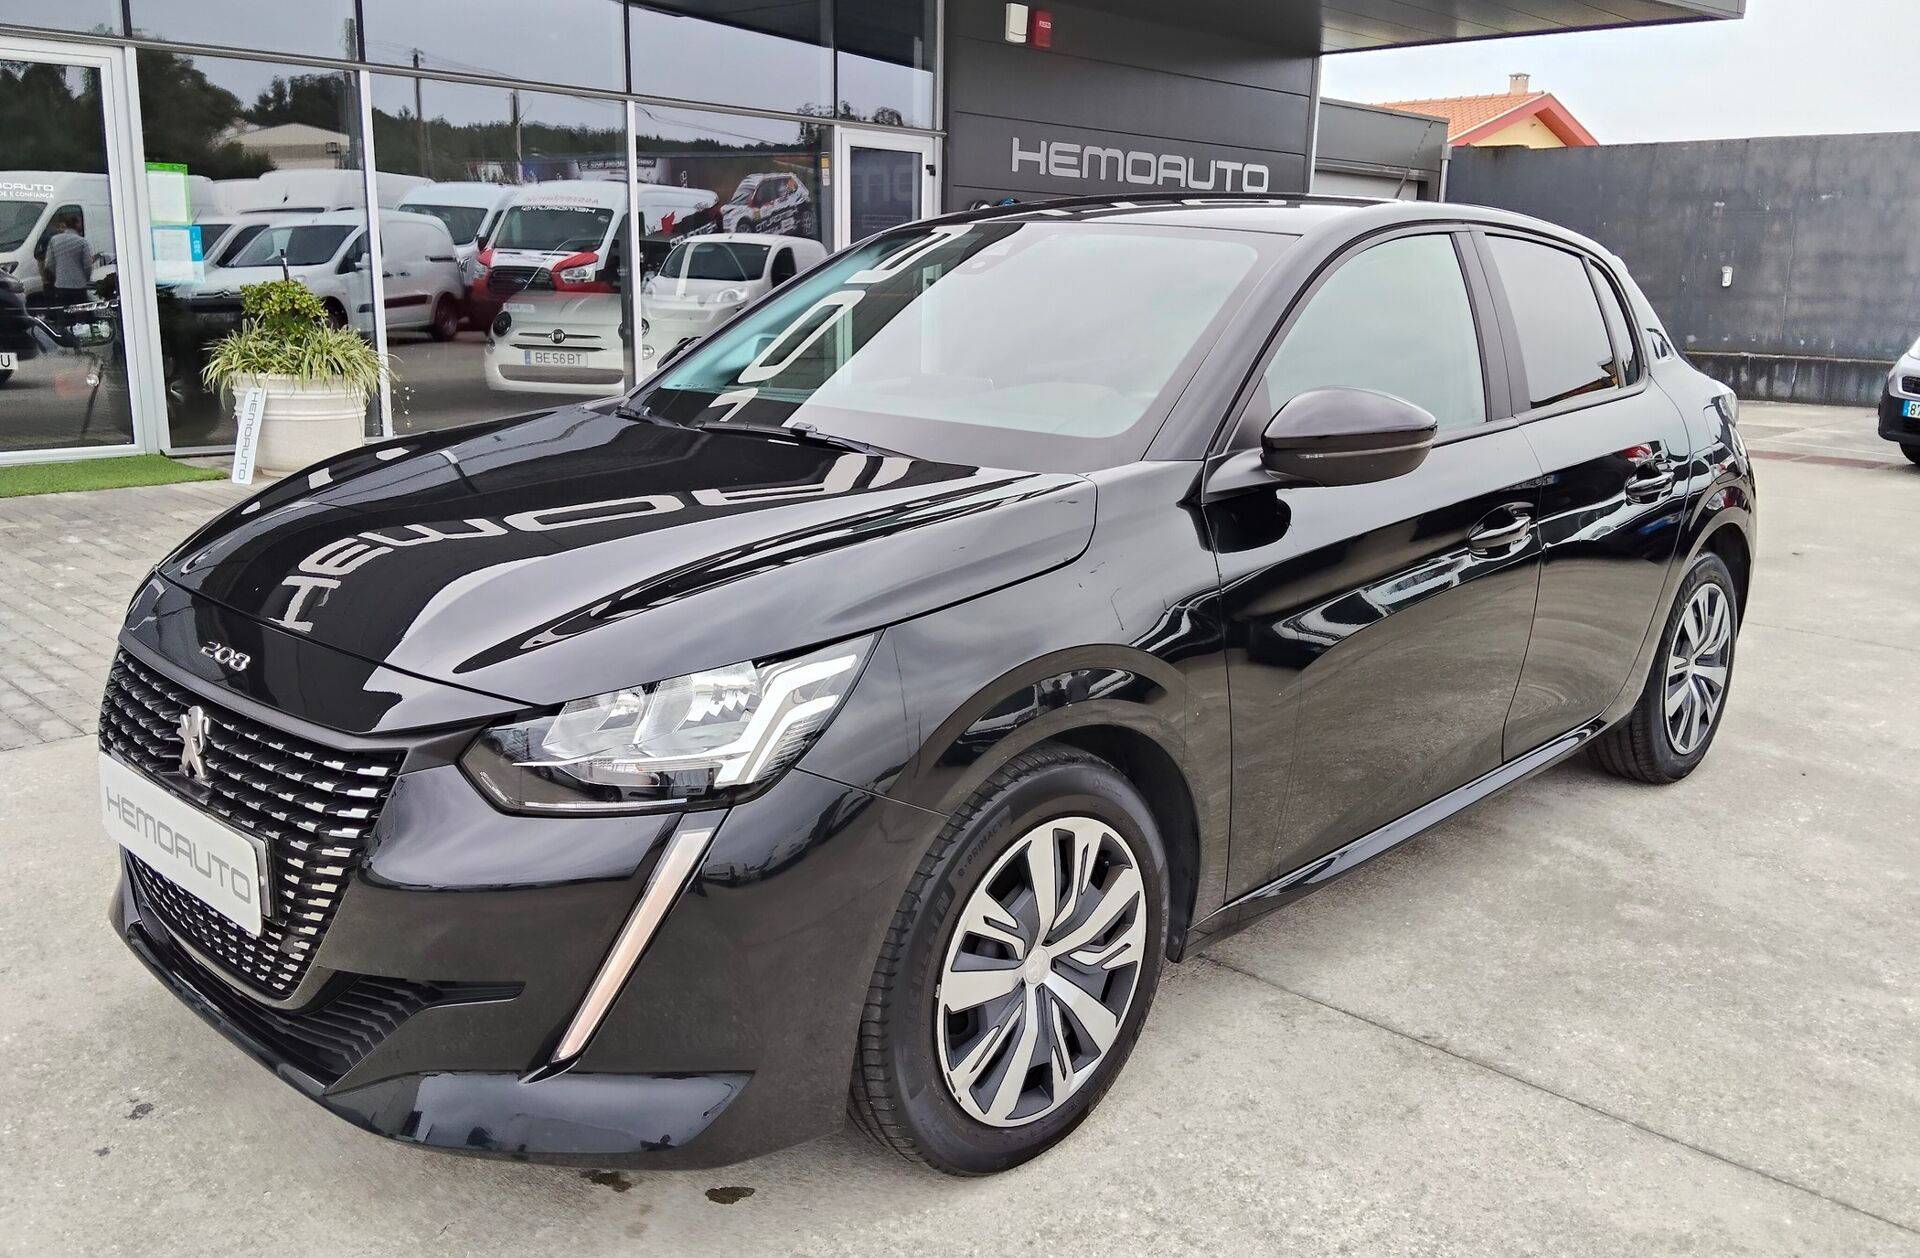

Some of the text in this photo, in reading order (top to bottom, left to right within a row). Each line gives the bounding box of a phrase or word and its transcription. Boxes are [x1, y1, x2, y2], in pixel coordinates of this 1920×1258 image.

[1011, 137, 1269, 193] HEMOAUTO
[238, 391, 260, 480] HEMOAUTO
[199, 640, 252, 673] 208
[105, 785, 252, 905] HEMOAUTO
